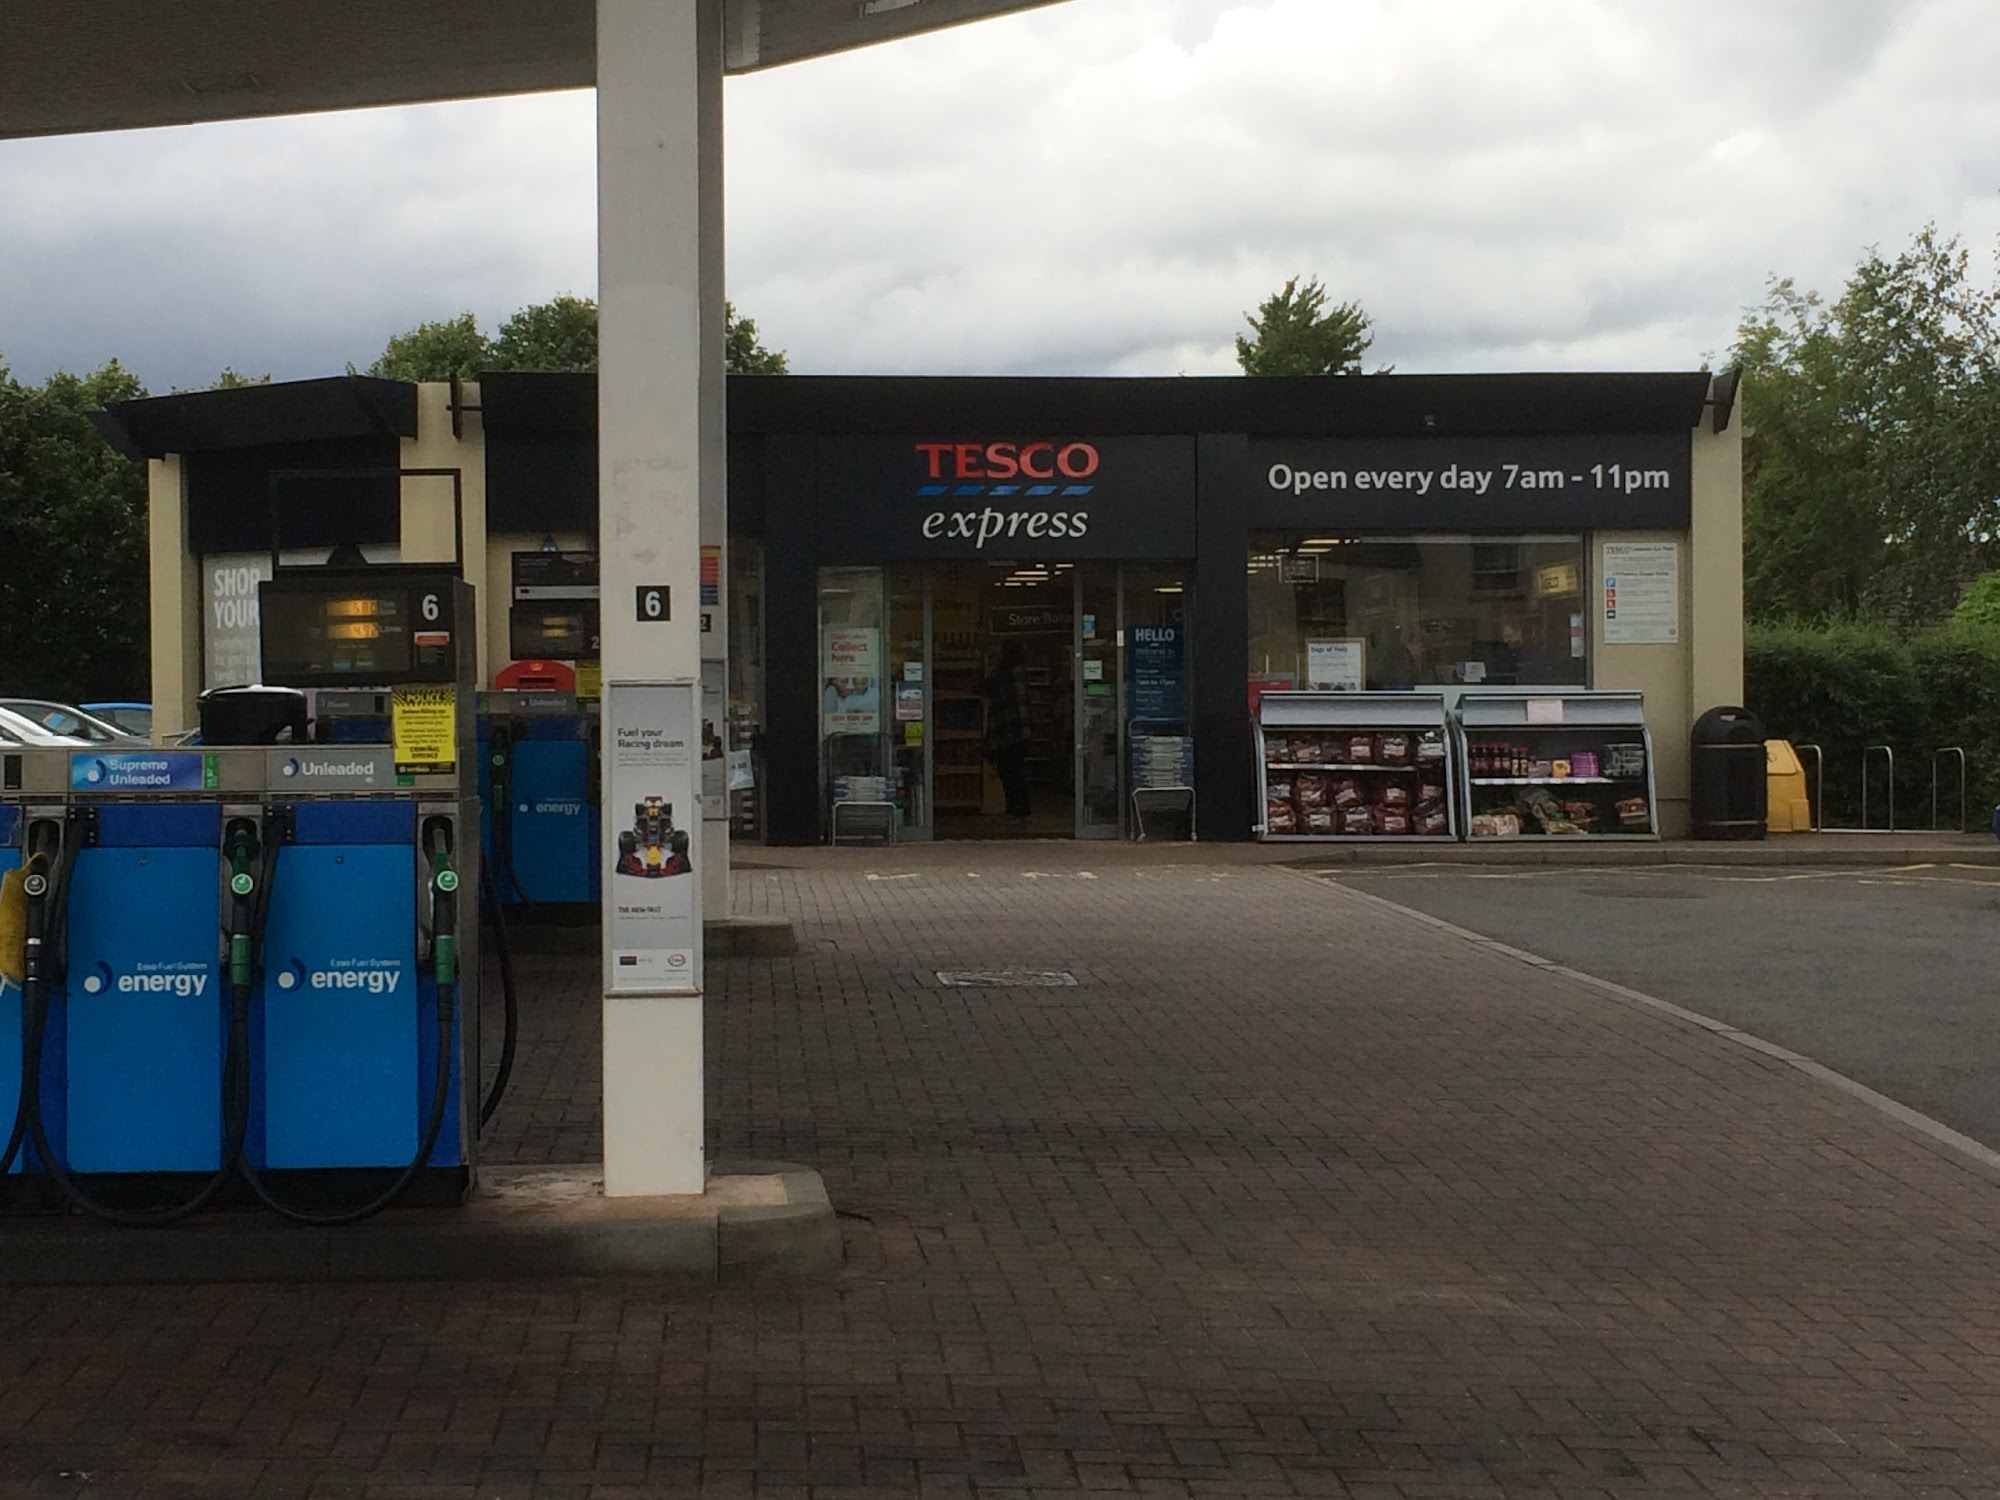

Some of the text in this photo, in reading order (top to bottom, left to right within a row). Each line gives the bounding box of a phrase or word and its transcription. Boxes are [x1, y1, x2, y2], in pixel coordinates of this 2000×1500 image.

[915, 442, 1099, 479] TESCO
[1267, 463, 1347, 494] Open
[1354, 470, 1433, 494] every
[1440, 463, 1492, 494] day
[1501, 464, 1564, 489] 7am
[1590, 464, 1670, 494] 11pm
[922, 506, 1088, 549] express
[214, 567, 261, 597] SHOP
[422, 594, 440, 621] 6
[645, 590, 662, 617] 6
[214, 599, 260, 629] YOUR
[1008, 613, 1041, 626] Store
[590, 635, 600, 650] 2
[1135, 628, 1176, 642] HELLO
[831, 641, 868, 652] Collect
[617, 728, 664, 739] Fuel your
[617, 739, 684, 751] Racing dream
[110, 760, 168, 772] Supreme
[301, 762, 374, 776] Unleaded
[110, 774, 171, 785] Unleaded
[535, 803, 581, 815] energy
[117, 974, 208, 998] energy
[311, 970, 401, 993] energy
